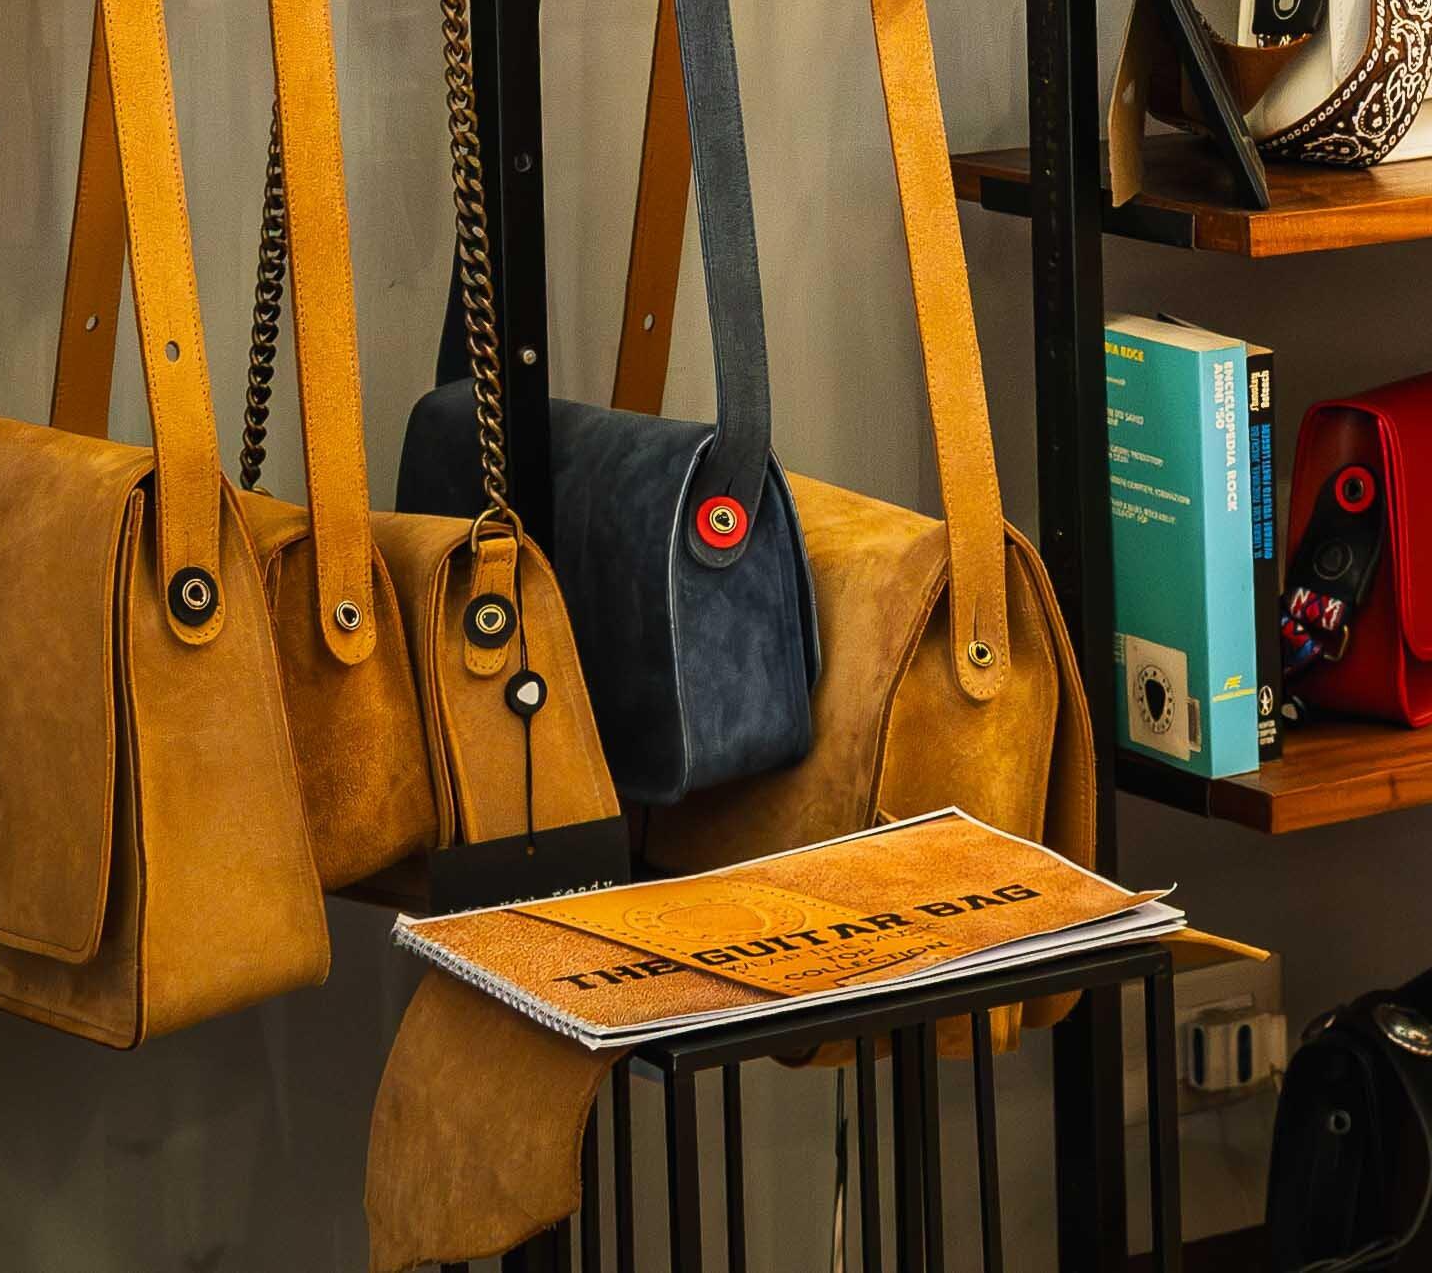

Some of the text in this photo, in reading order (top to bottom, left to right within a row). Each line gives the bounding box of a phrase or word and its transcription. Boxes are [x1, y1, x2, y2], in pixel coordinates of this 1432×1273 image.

[1213, 363, 1223, 403] ANNI
[1223, 361, 1238, 512] ENCICLOPEDIA ROCK
[552, 883, 1042, 992] THE GUITAR BAG
[823, 947, 880, 966] TOP
[782, 940, 952, 983] COLLECTION
